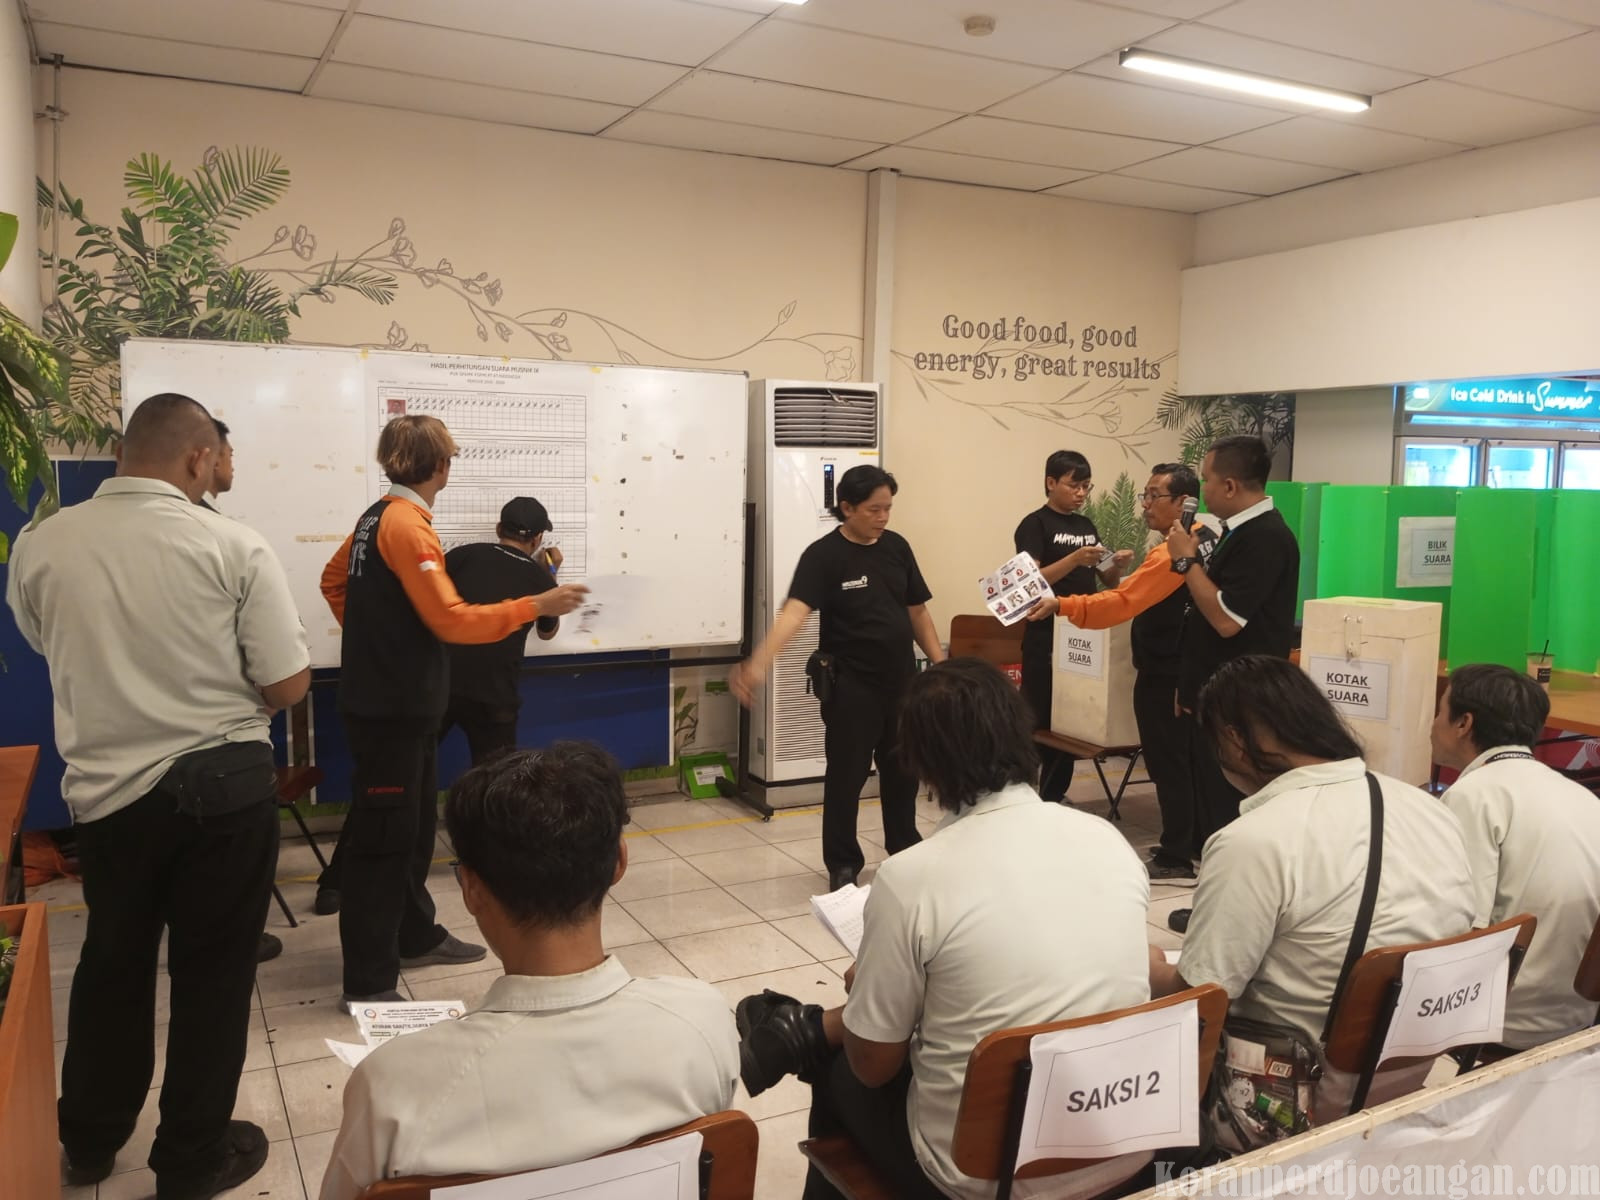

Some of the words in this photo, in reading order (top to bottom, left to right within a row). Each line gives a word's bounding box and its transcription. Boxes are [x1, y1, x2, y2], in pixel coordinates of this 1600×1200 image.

[942, 314, 1006, 342] Good
[1013, 316, 1074, 349] food,
[1081, 325, 1137, 352] good
[914, 351, 1007, 380] energy,
[1014, 353, 1078, 381] great
[1083, 357, 1161, 380] results
[1450, 386, 1468, 402] Ice
[1469, 387, 1495, 403] Cold
[1497, 389, 1524, 404] Drink
[1427, 540, 1448, 550] BILIK
[1423, 554, 1451, 565] SUARA
[1067, 637, 1092, 650] KOTAK
[1067, 651, 1092, 665] SUARA
[1326, 672, 1369, 686] KOTAK
[1327, 689, 1369, 704] SUARA
[1416, 986, 1470, 1017] SAKSI
[1470, 982, 1482, 1002] 3
[1066, 1074, 1141, 1113] SAKSI
[1145, 1070, 1161, 1096] 2
